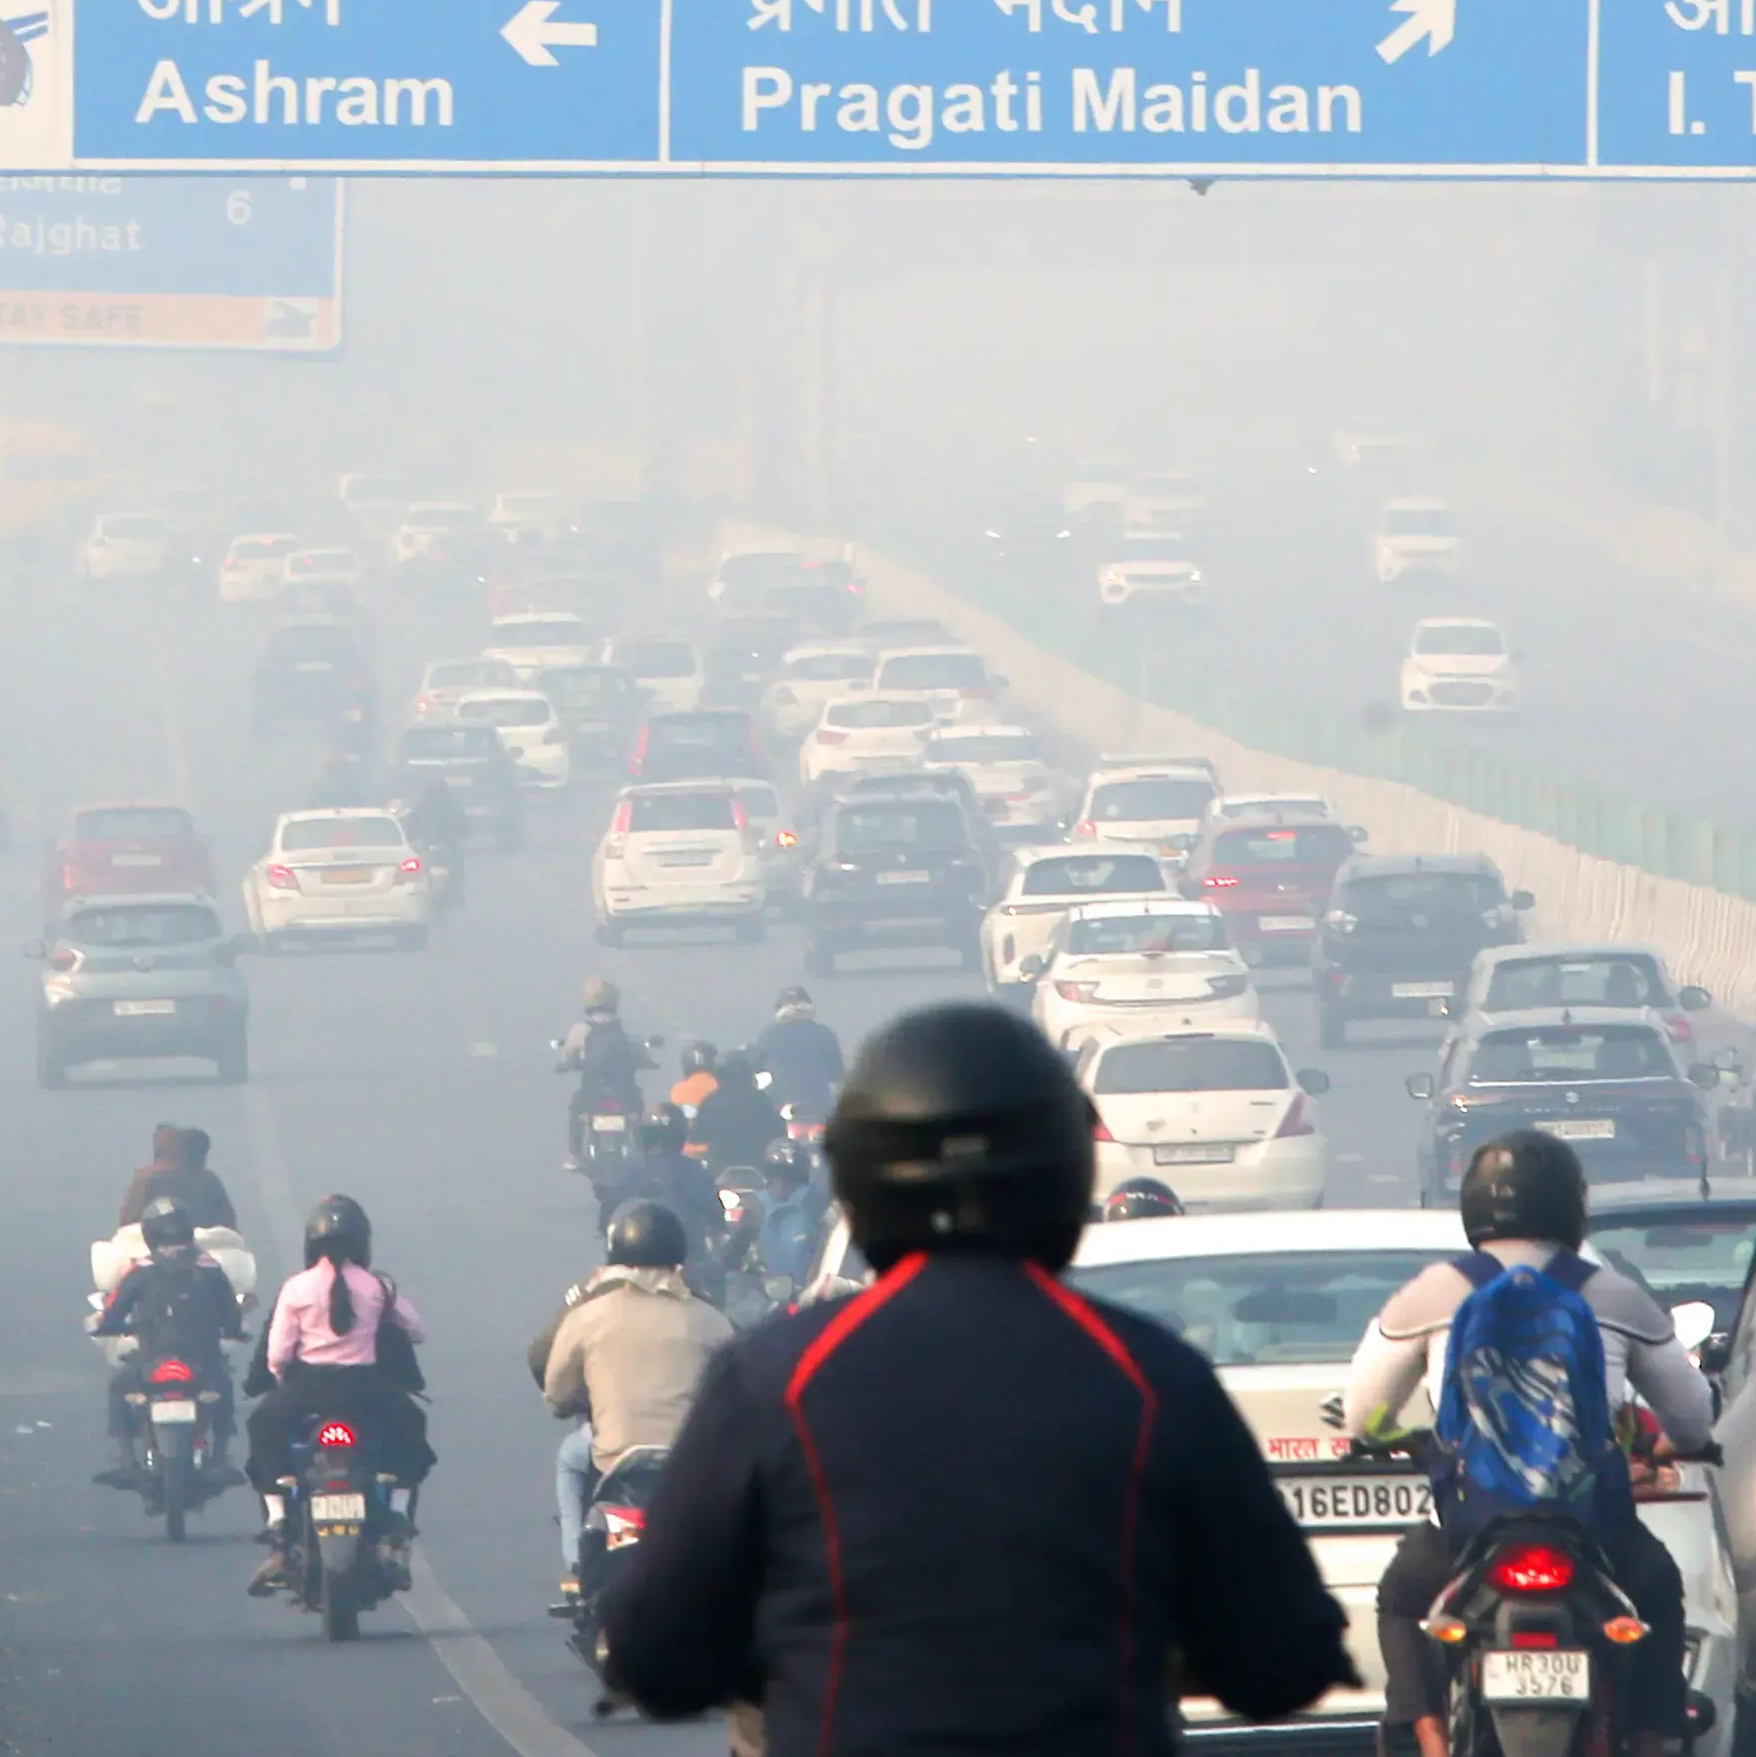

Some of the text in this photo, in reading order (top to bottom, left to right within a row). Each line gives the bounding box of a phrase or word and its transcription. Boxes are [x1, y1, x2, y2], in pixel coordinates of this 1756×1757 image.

[134, 59, 454, 126] Ashram
[742, 66, 1362, 150] Pragati Maidan
[1668, 68, 1705, 135] I.
[226, 189, 253, 226] 6
[59, 301, 144, 332] SAFE
[1267, 1436, 1320, 1460] भारत
